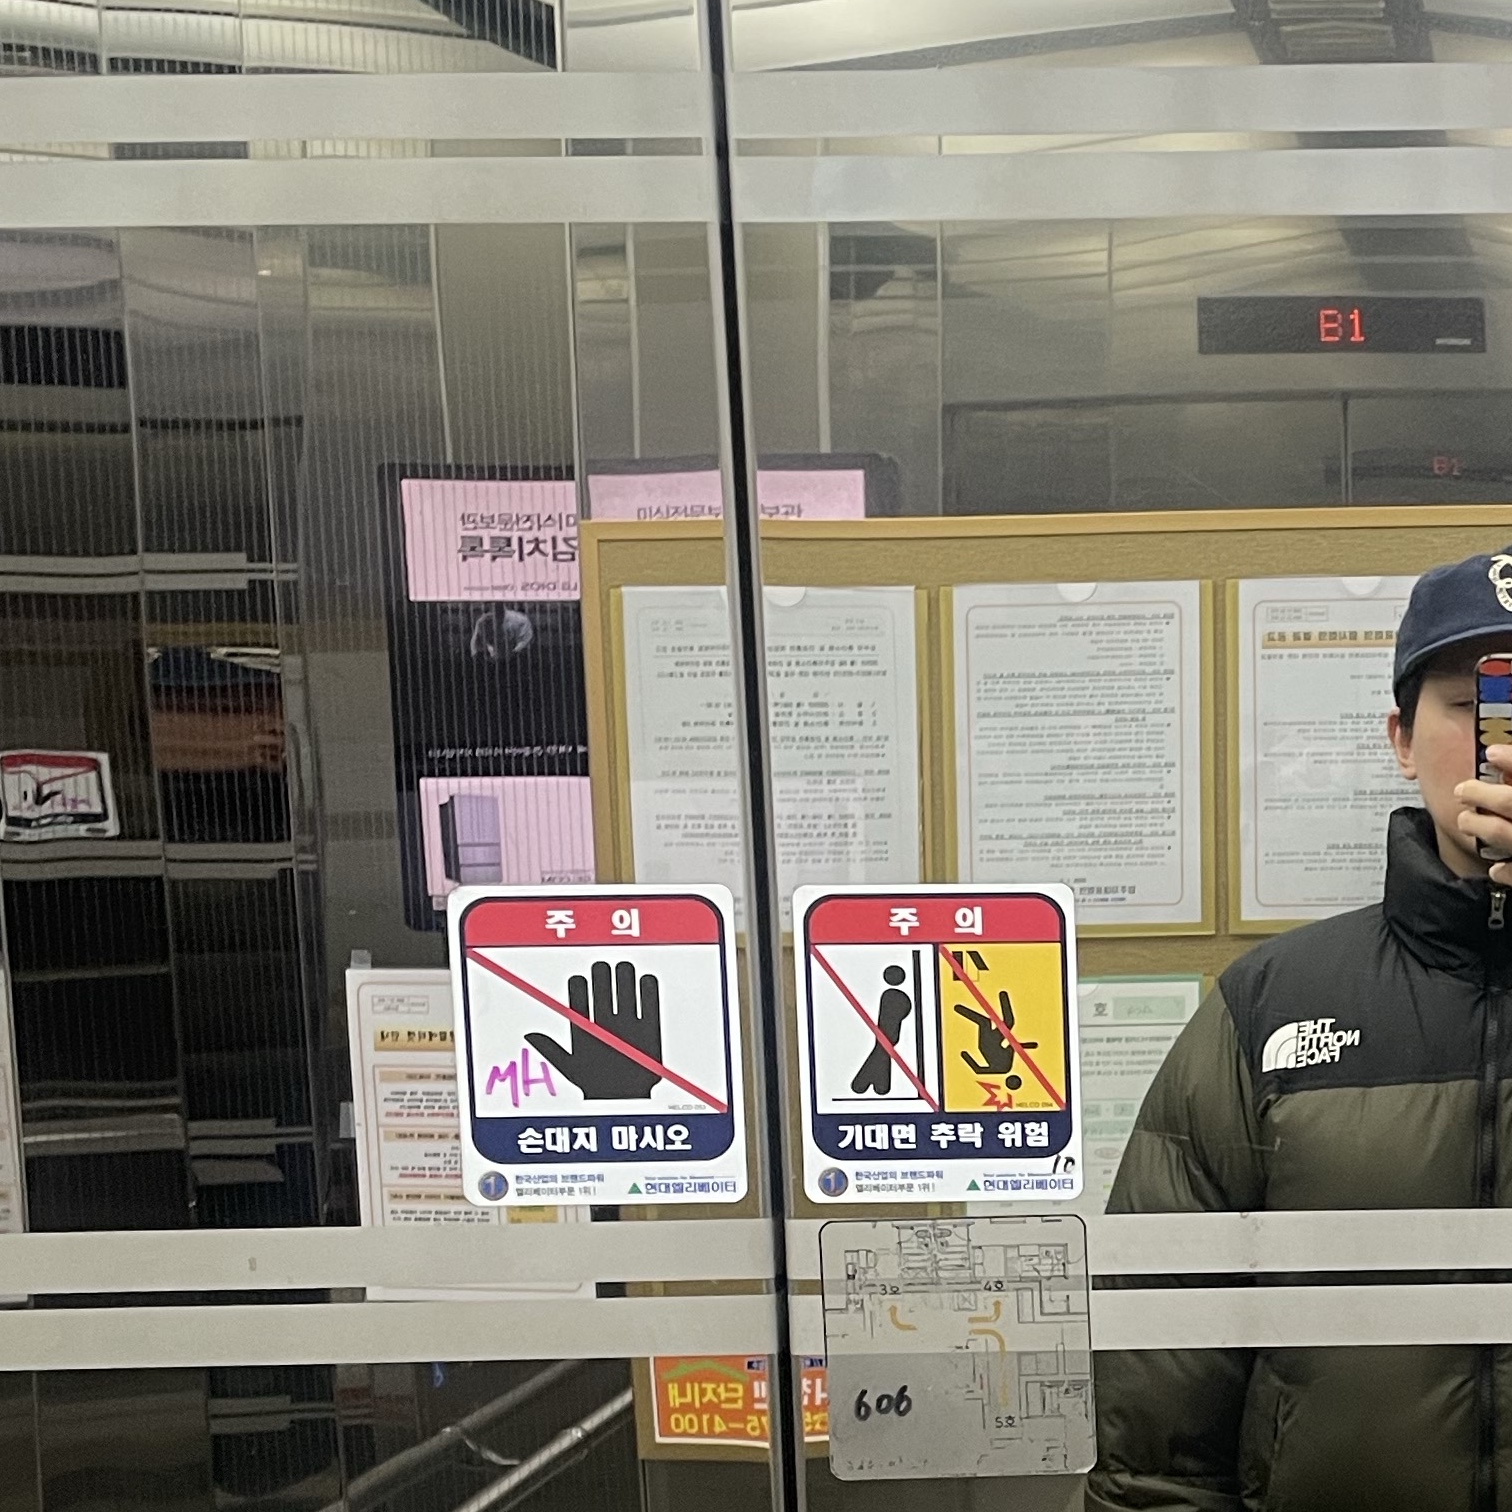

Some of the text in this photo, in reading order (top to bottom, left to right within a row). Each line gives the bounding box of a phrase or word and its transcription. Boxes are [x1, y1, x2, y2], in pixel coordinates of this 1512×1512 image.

[1319, 308, 1365, 343] B1
[517, 1125, 692, 1154] 손대지 마시오
[837, 1121, 1050, 1150] 기대면 추락 위험
[644, 1181, 737, 1194] 현대엘리베이터
[983, 1179, 1075, 1191] 현대엘리베이터
[853, 1384, 913, 1422] 606
